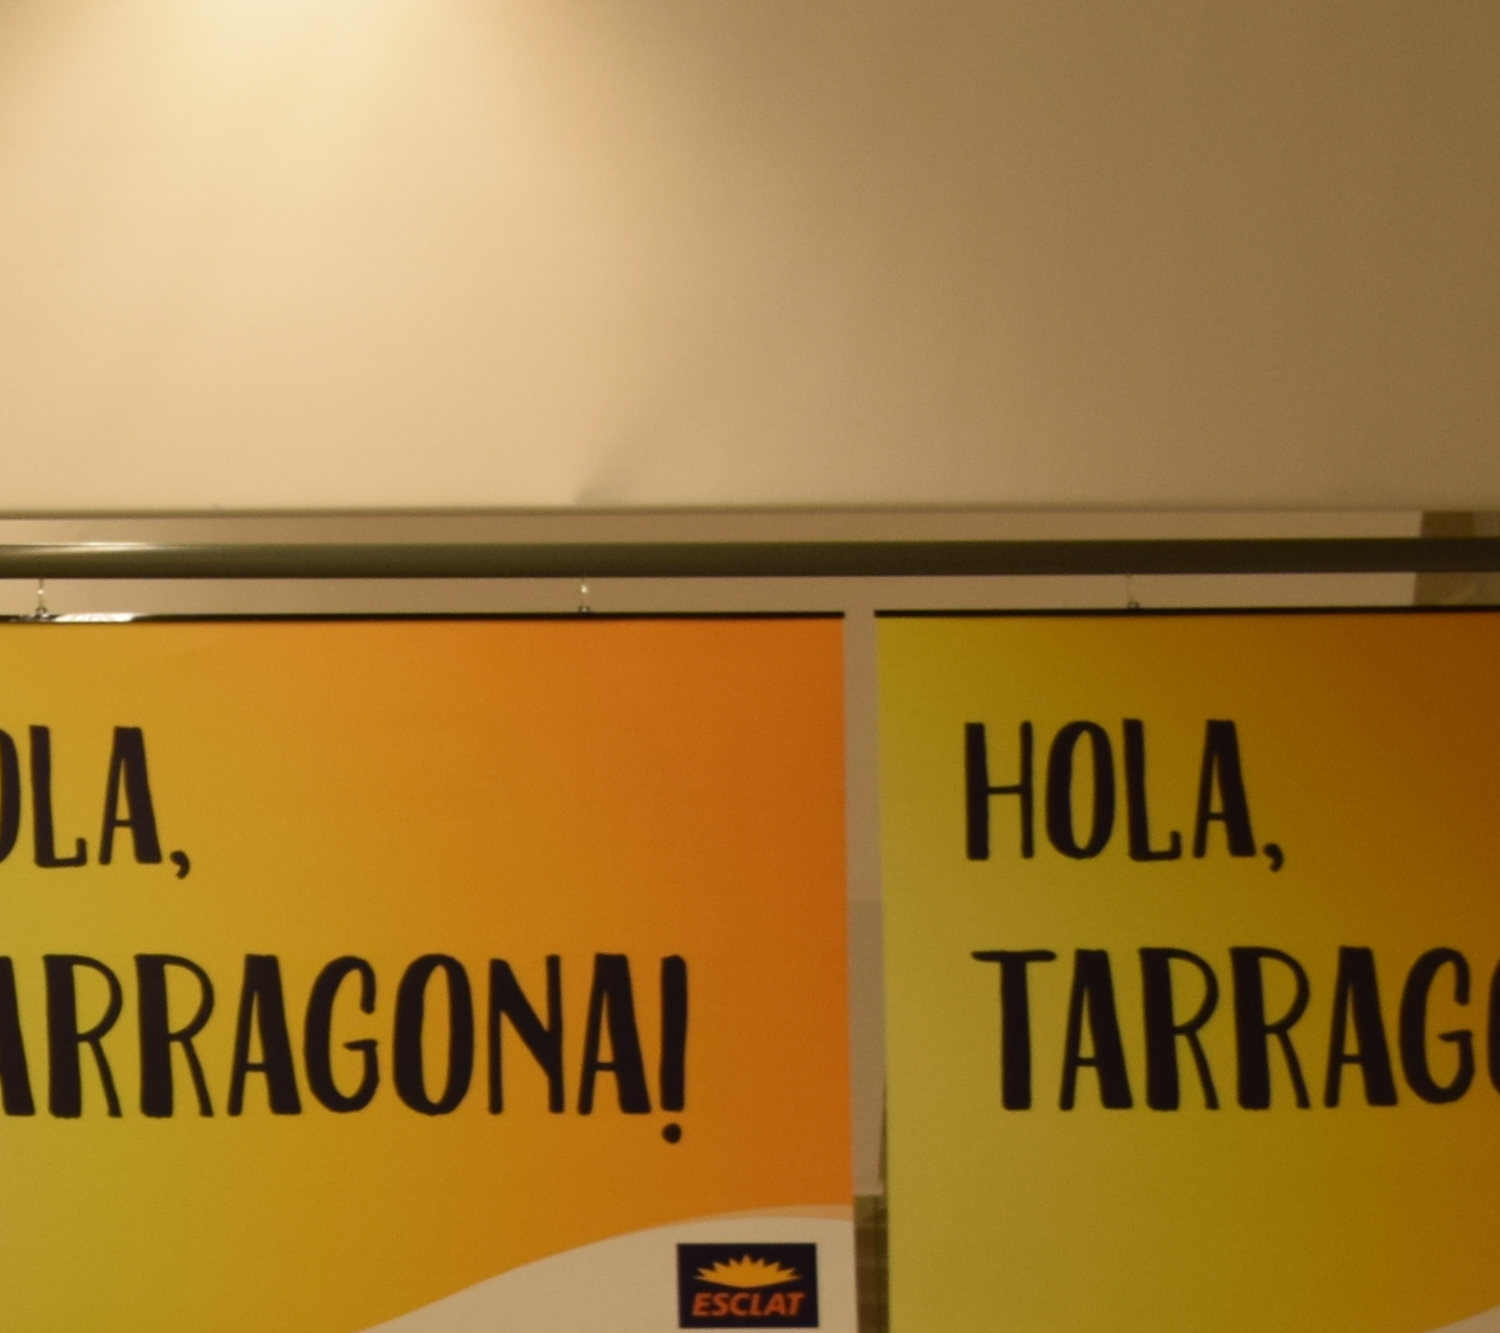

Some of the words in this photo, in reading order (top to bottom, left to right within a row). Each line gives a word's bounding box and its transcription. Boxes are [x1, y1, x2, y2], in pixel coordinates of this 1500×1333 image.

[964, 717, 1284, 872] HOLA,
[971, 945, 1500, 1112] TARRAG
[691, 1289, 804, 1317] ESCLAT
